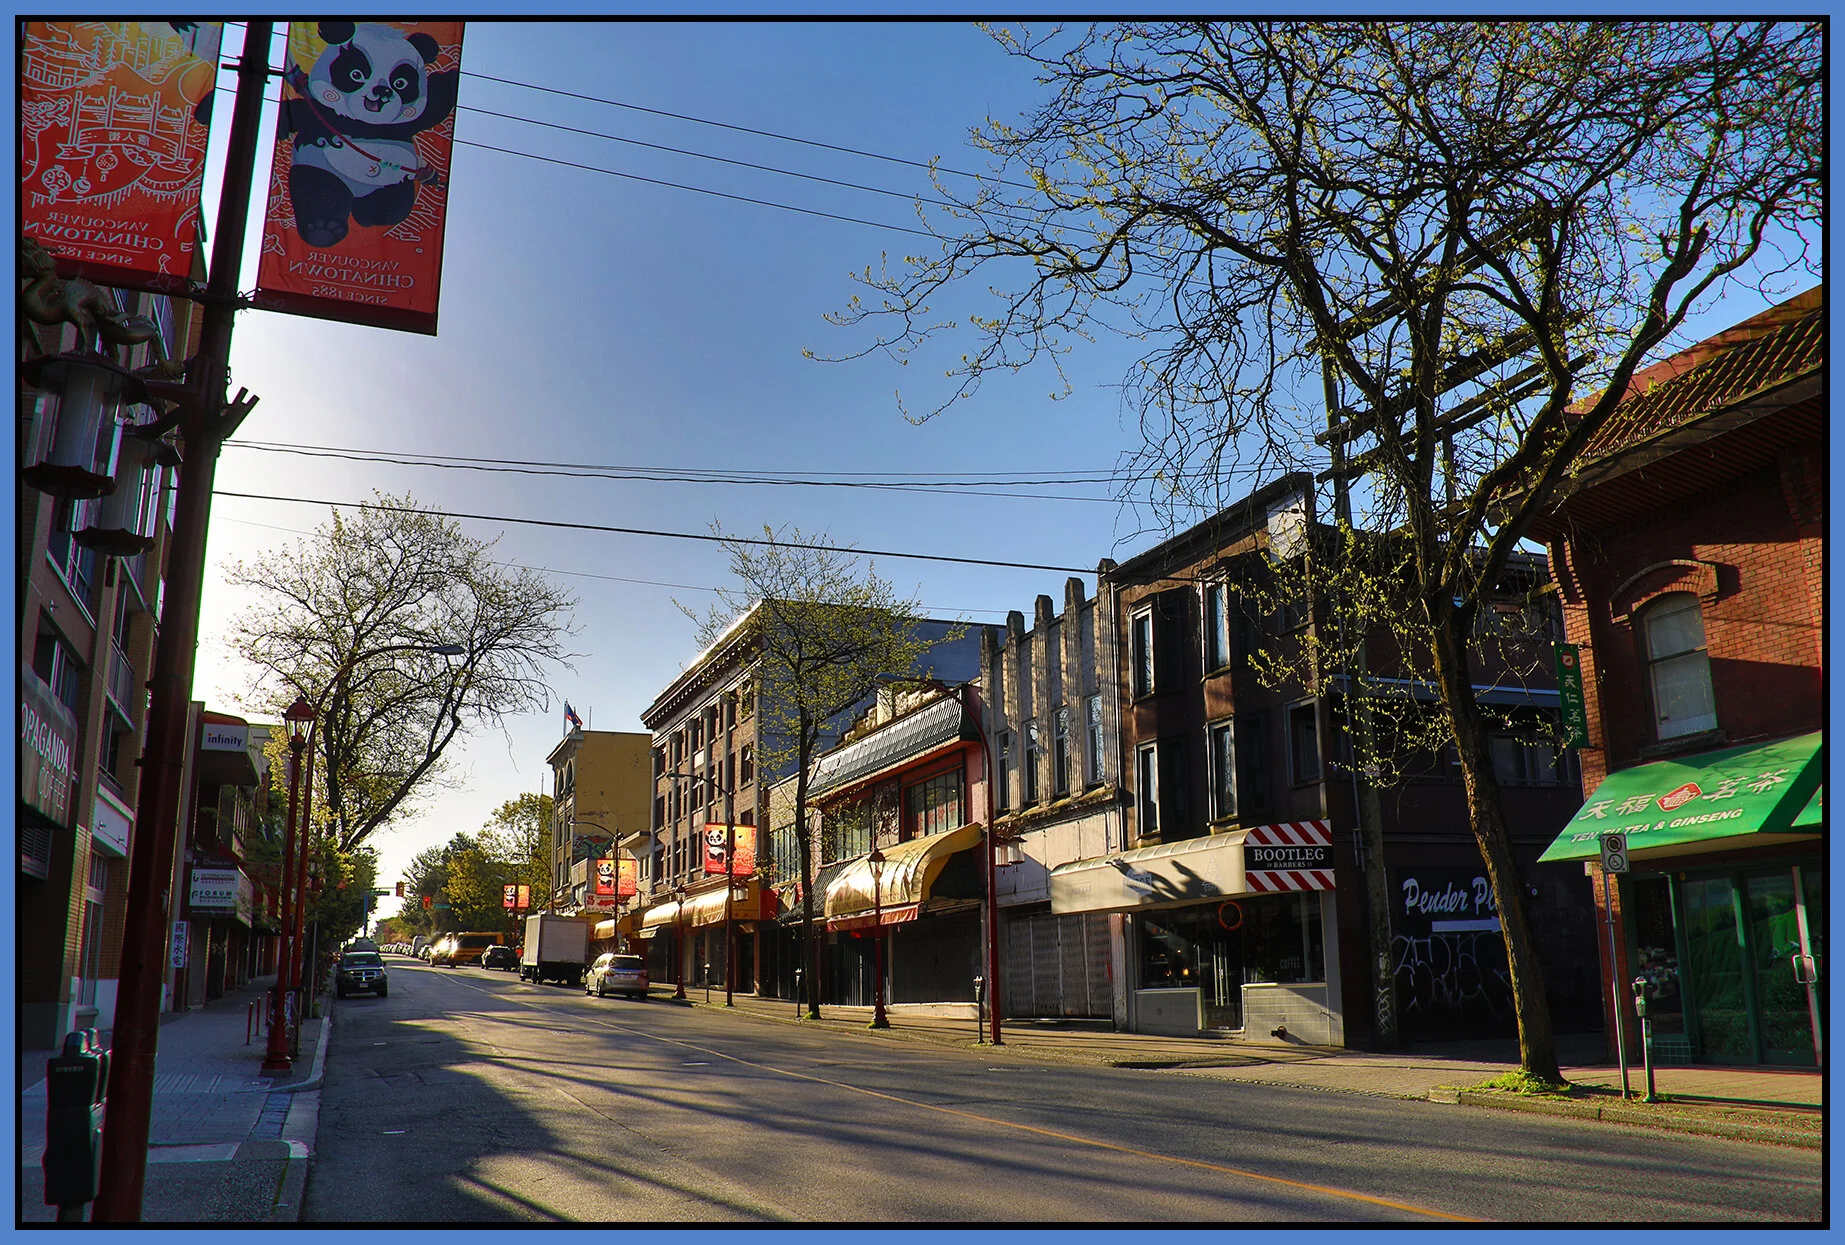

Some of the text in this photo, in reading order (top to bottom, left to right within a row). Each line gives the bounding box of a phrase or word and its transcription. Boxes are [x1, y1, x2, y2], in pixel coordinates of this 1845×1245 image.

[208, 732, 243, 748] infinity
[39, 766, 66, 810] COFFEE
[1570, 830, 1600, 843] TEN
[1624, 823, 1651, 835] TEA
[1652, 820, 1666, 831] &
[1669, 808, 1744, 828] GINSENG
[1253, 848, 1325, 861] BOOTLEG
[1273, 861, 1306, 869] BARBERS
[1402, 877, 1469, 915] Pender
